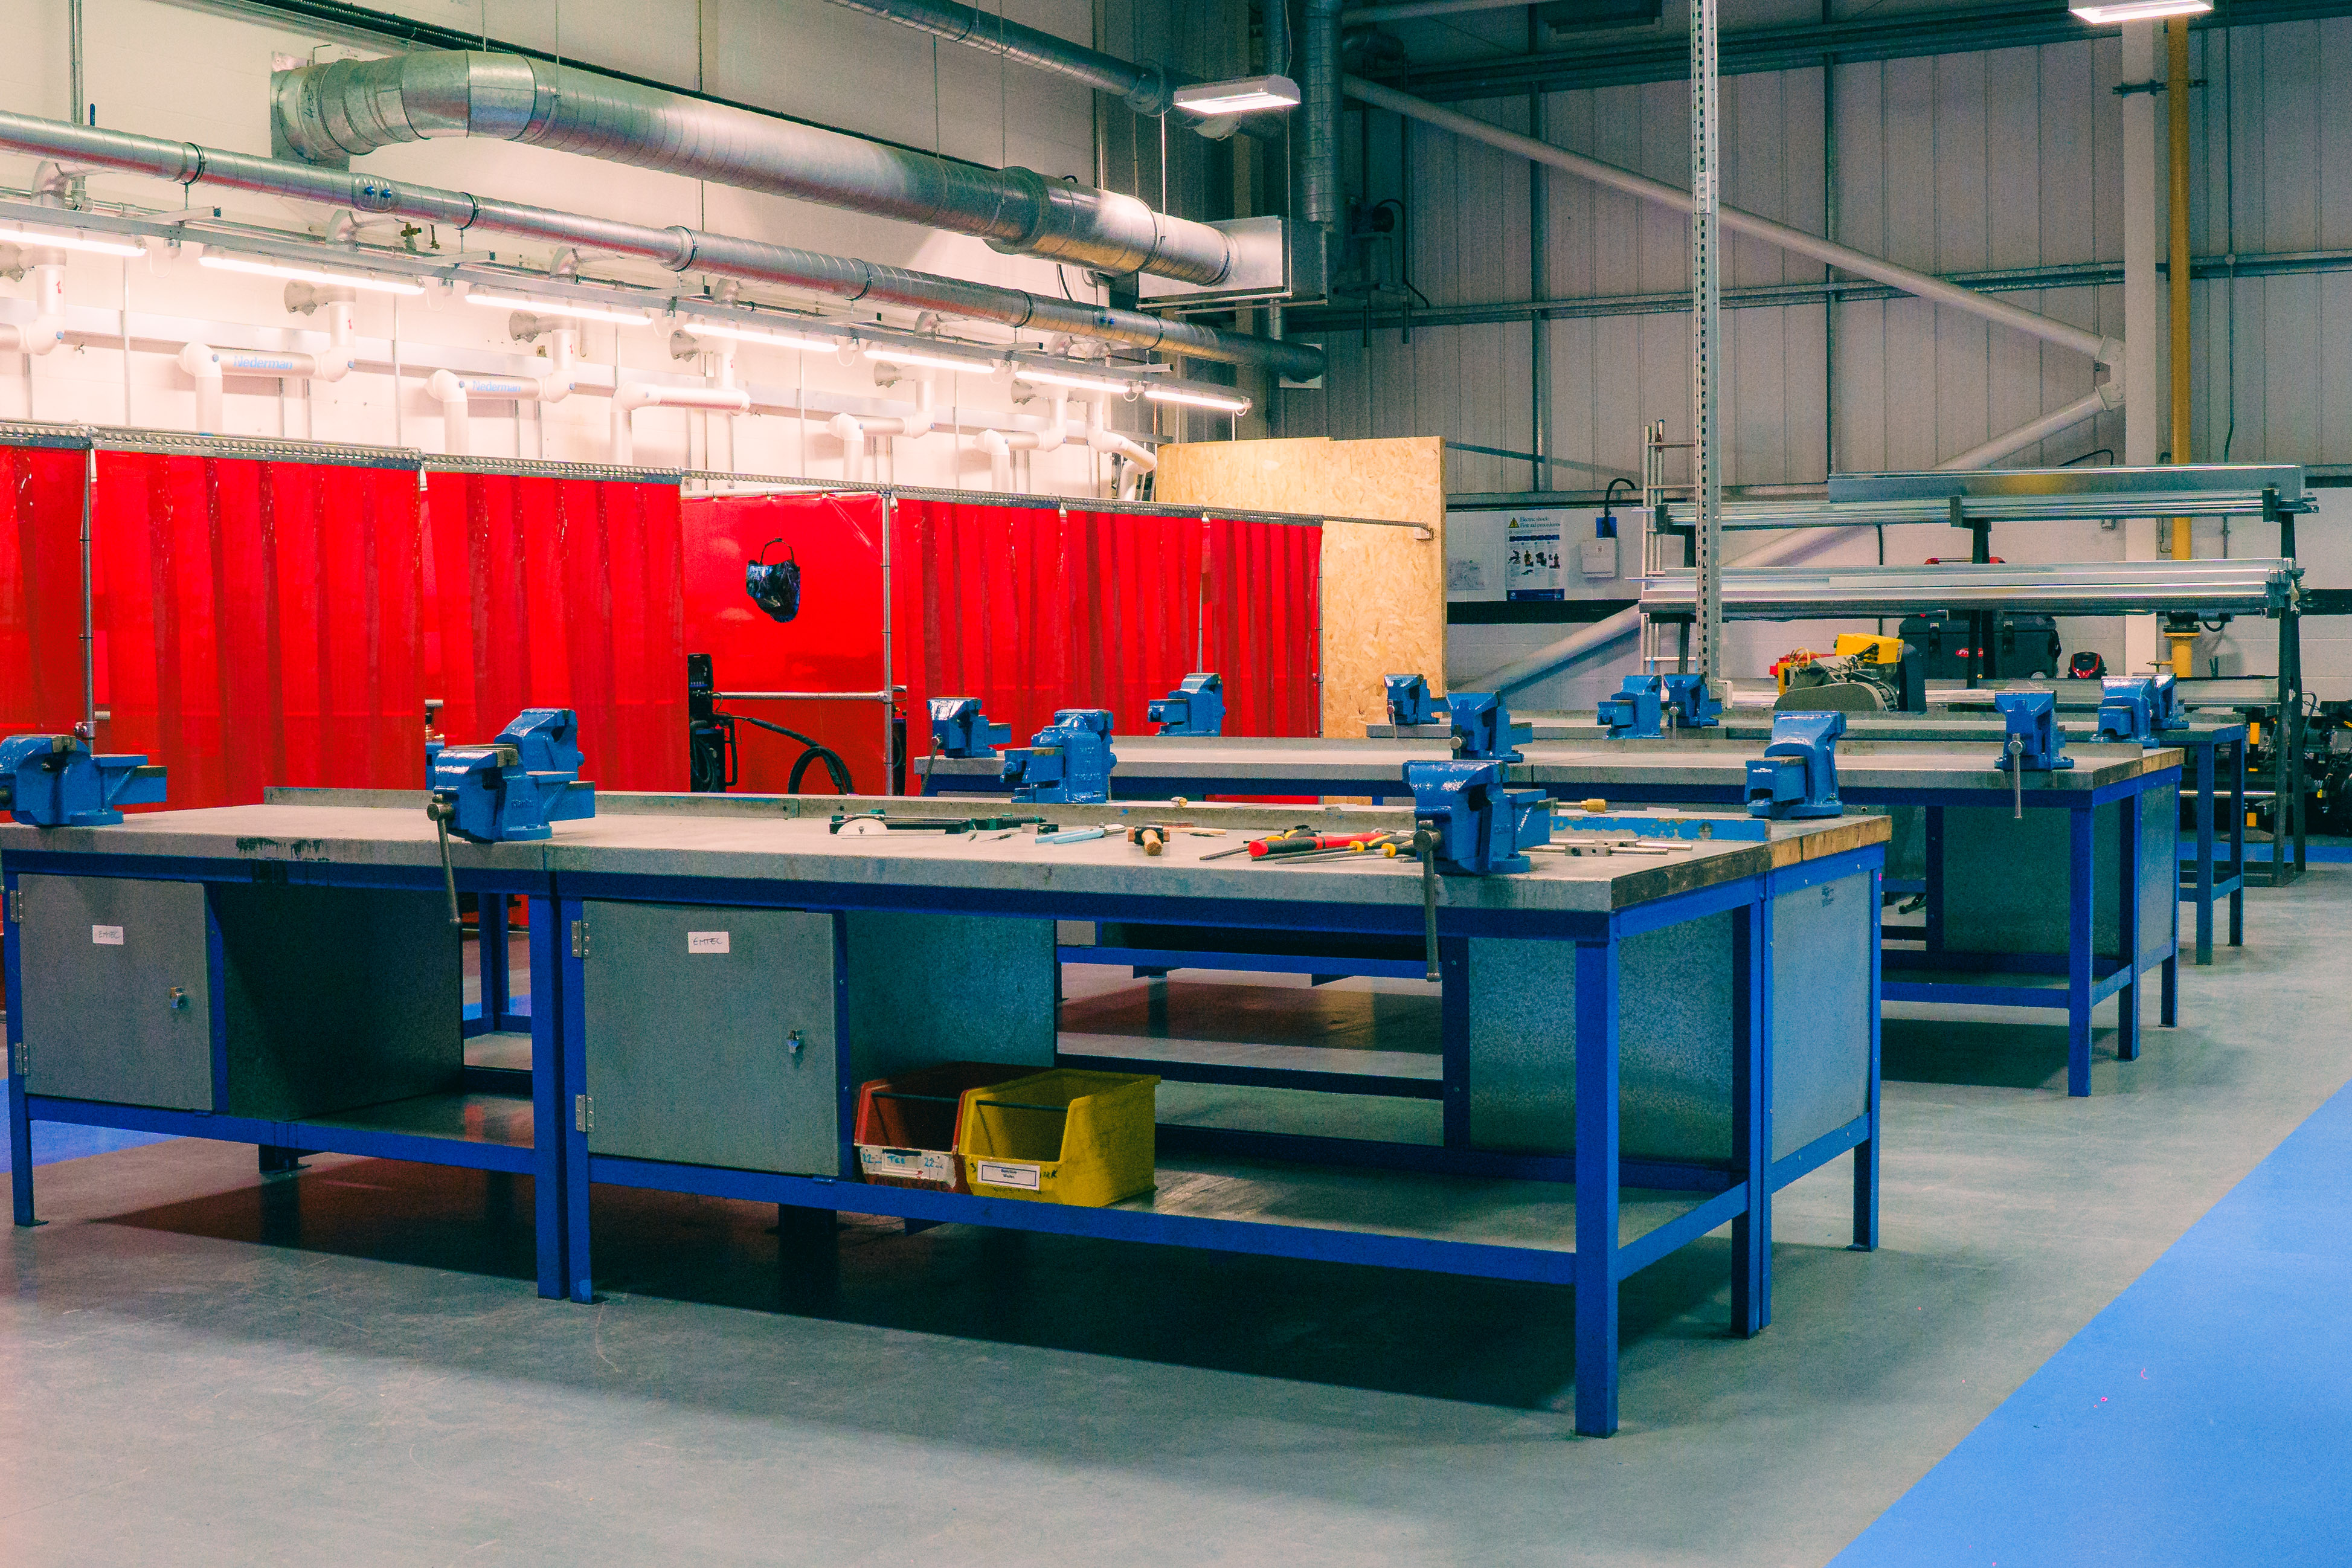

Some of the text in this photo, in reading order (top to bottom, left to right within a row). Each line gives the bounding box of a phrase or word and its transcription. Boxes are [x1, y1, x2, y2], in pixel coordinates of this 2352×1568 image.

[234, 355, 293, 370] Nederman
[473, 380, 521, 392] Nederman
[693, 937, 723, 946] EMTEC
